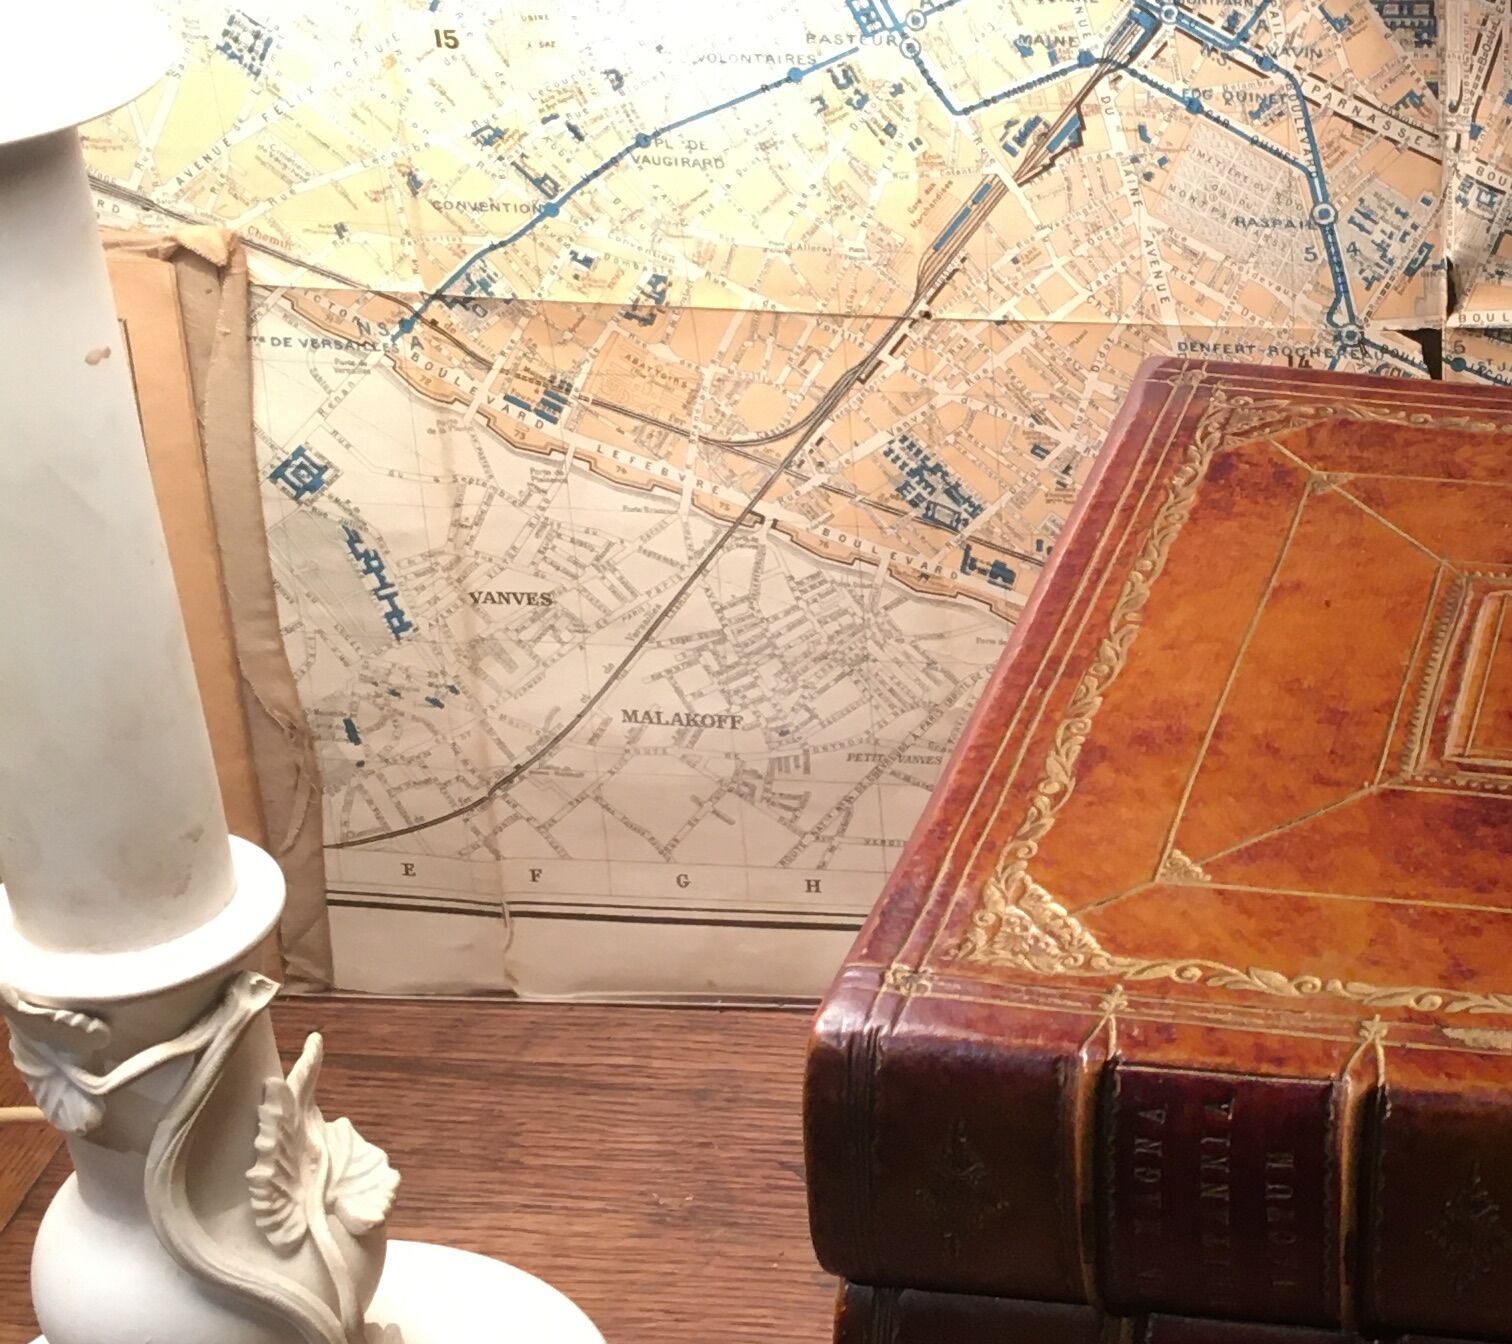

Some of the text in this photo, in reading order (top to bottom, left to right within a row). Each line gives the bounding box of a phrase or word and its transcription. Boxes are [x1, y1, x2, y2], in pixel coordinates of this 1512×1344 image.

[434, 29, 460, 49] 15
[631, 154, 726, 169] VAUGIRARD
[432, 199, 542, 214] CONVENTION
[1144, 238, 1170, 305] AVENUE
[822, 526, 959, 580] BOULEVARD
[468, 590, 555, 608] VANVES
[621, 708, 744, 731] MALAKOFF
[402, 862, 417, 878] E
[528, 868, 543, 884] F
[676, 873, 692, 889] G
[804, 879, 822, 894] H
